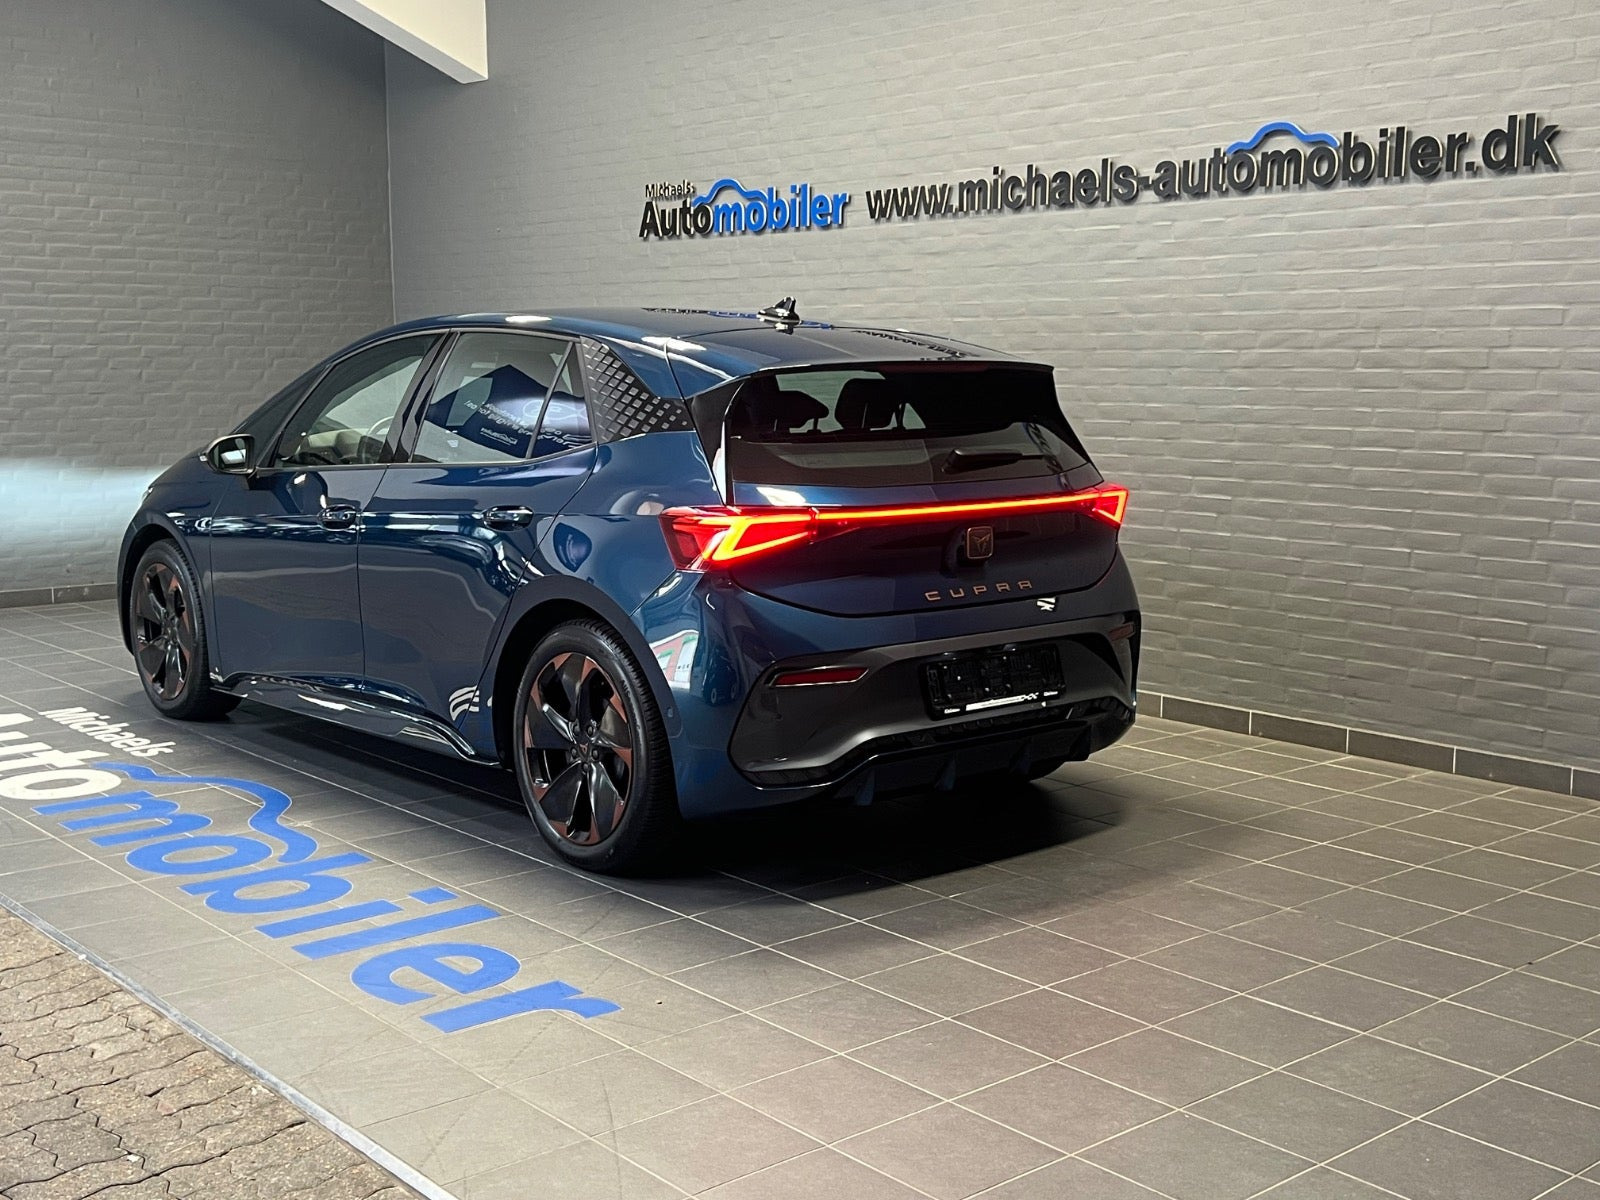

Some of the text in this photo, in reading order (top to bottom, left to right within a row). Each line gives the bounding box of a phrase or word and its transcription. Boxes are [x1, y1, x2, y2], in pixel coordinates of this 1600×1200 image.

[645, 180, 694, 198] Michaels
[866, 113, 1558, 219] www.michaels-automobiler.dk
[640, 184, 849, 237] Automobiler
[925, 580, 1033, 601] CUPRA
[38, 706, 177, 757] Michaels
